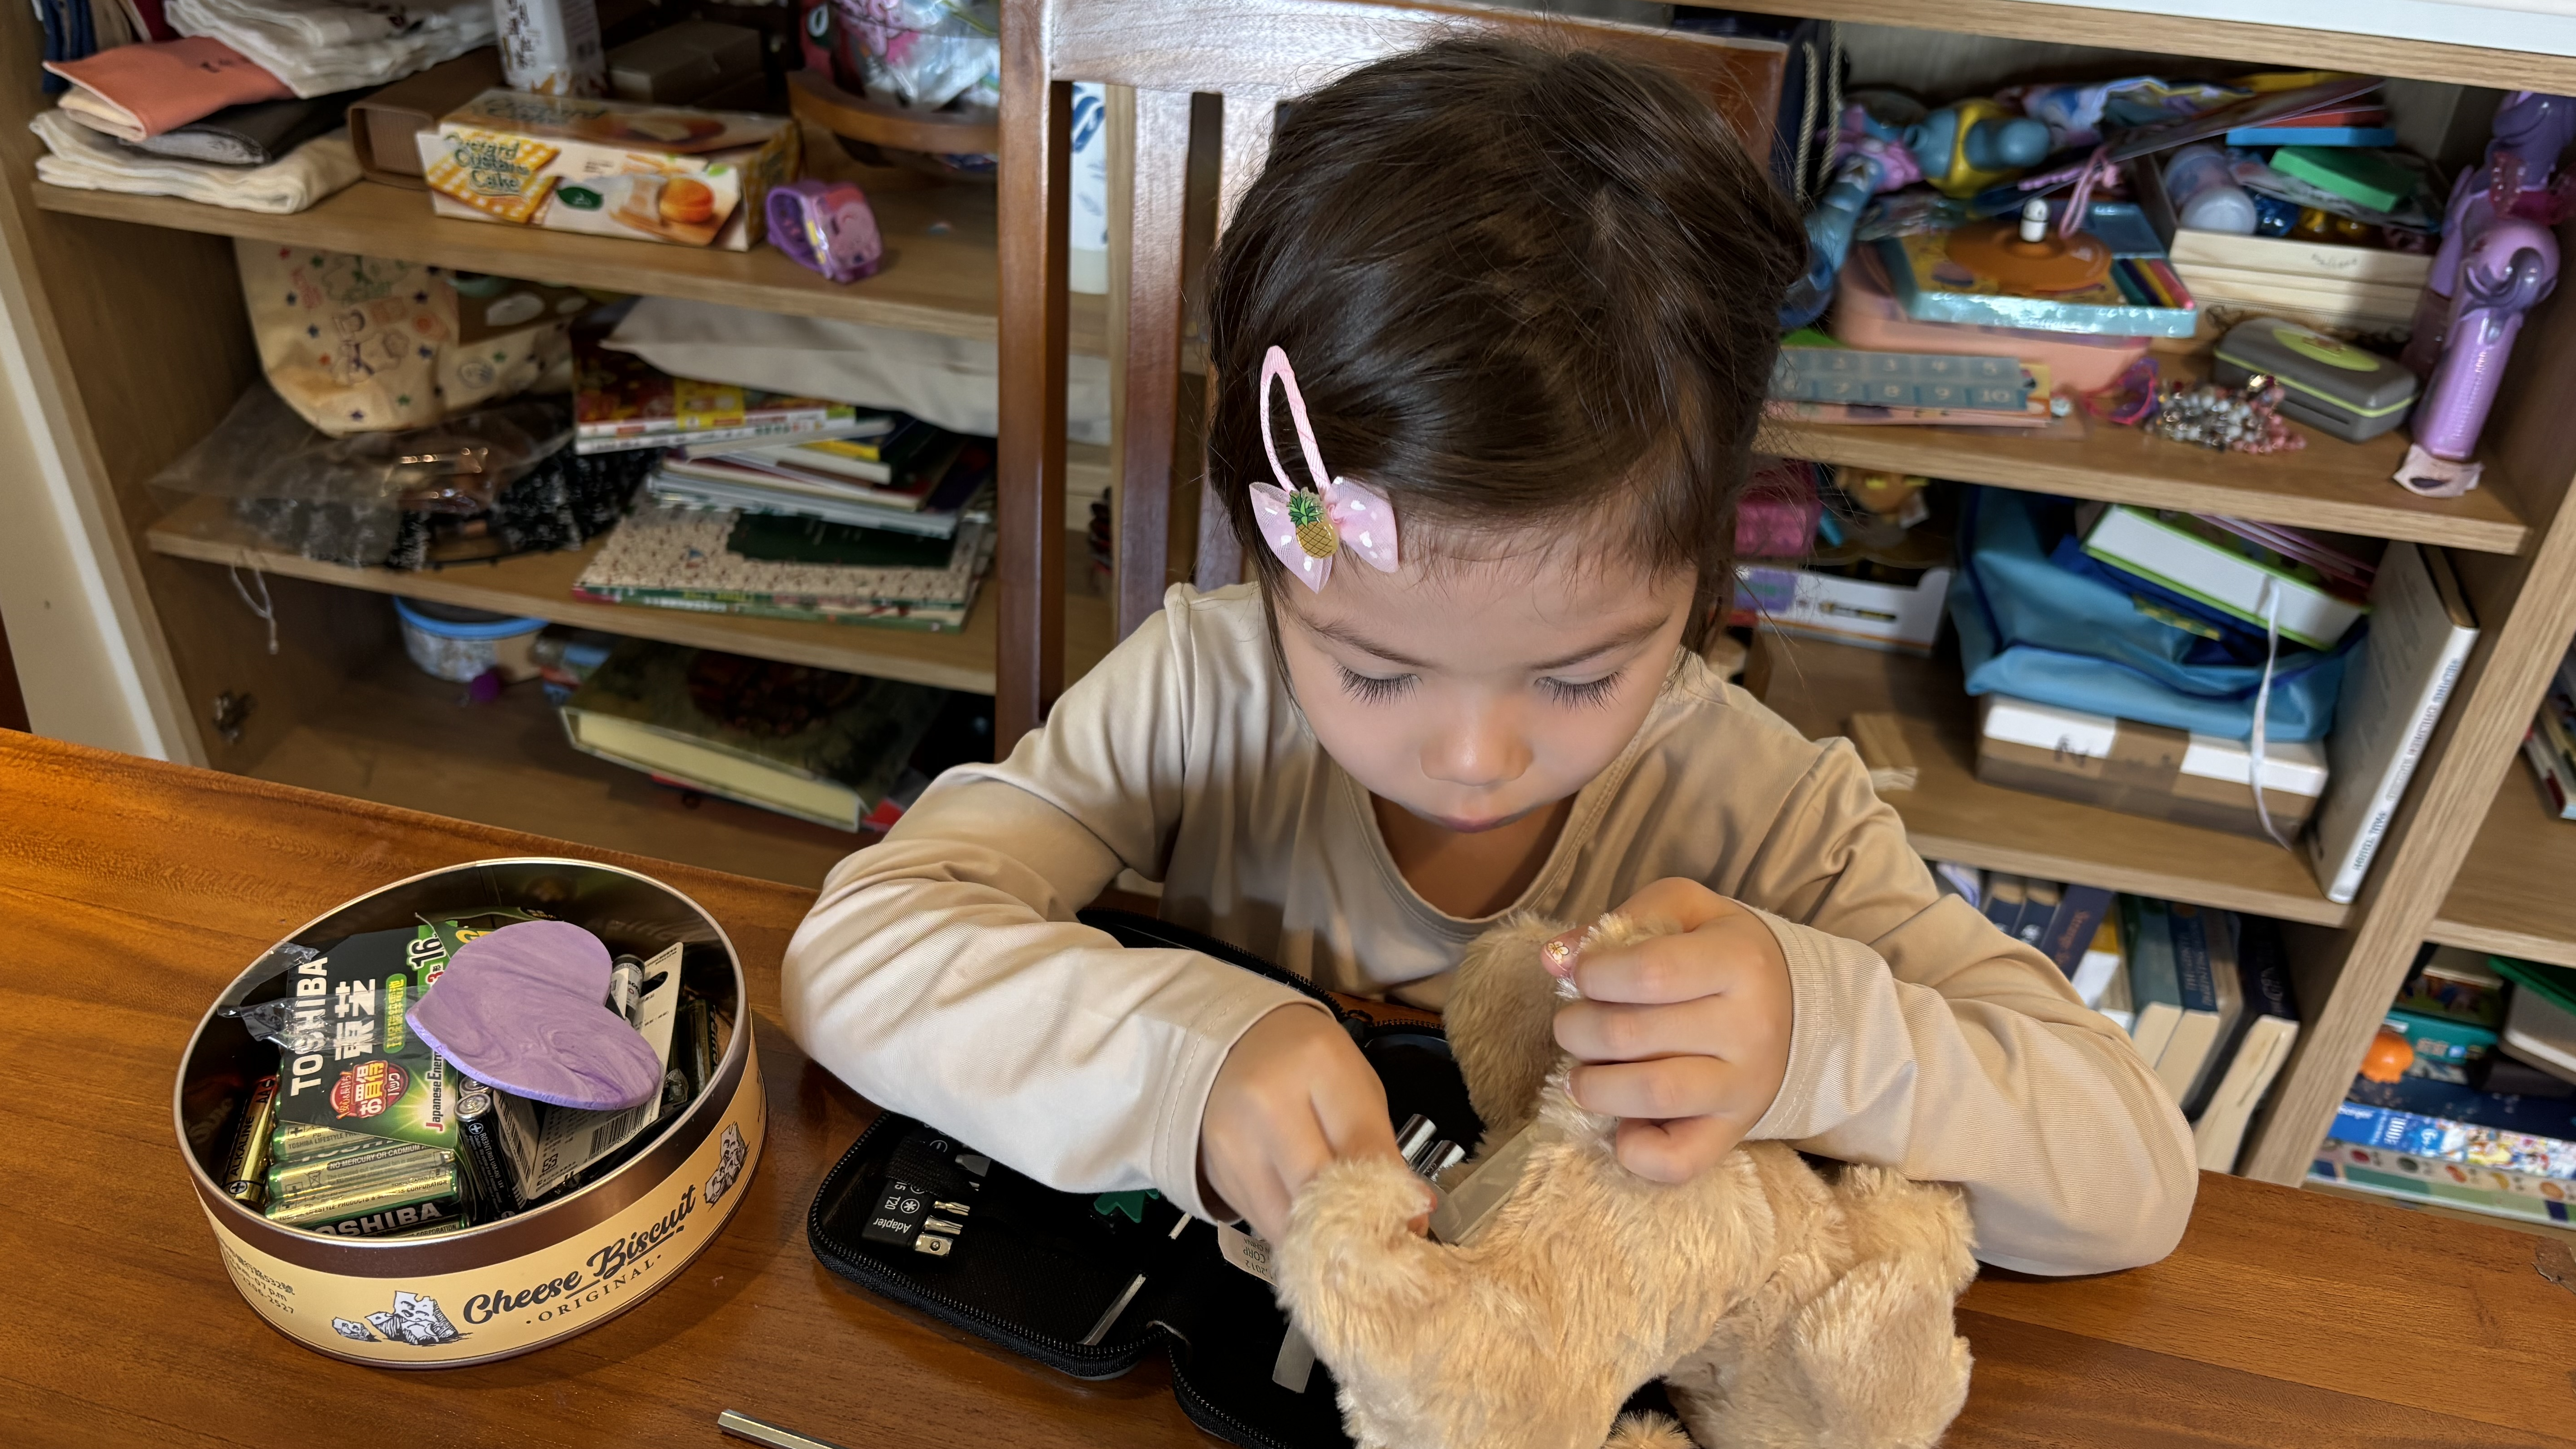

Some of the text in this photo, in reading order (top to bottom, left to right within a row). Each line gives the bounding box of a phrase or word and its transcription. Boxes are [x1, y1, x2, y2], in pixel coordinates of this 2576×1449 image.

[1884, 385, 1900, 397] 8
[1936, 387, 1950, 399] 9
[1983, 390, 2010, 402] 10
[291, 957, 328, 1096] TOSHIBA
[335, 979, 375, 1061] 東芝
[256, 1089, 272, 1104] AA
[355, 1062, 384, 1115] お買得
[387, 1072, 400, 1096] パック
[426, 1081, 444, 1132] Japanese
[230, 1115, 254, 1176] ALKALINE
[289, 1140, 313, 1149] TOSHIBA
[315, 1134, 344, 1144] LIFESTYLE
[330, 1162, 341, 1170] NO
[342, 1154, 375, 1167] MERCURY
[388, 1144, 421, 1156] CADMIUM
[338, 1196, 369, 1207] PRODUCTS
[407, 1181, 448, 1192] CORPORATION
[885, 1196, 901, 1210] T20
[315, 1202, 442, 1237] OSHIBA
[873, 1218, 912, 1233] Adapter
[463, 1185, 696, 1324] Cheese Biscuit
[1243, 1247, 1266, 1263] CORP
[539, 1259, 654, 1321] ORIGINAL
